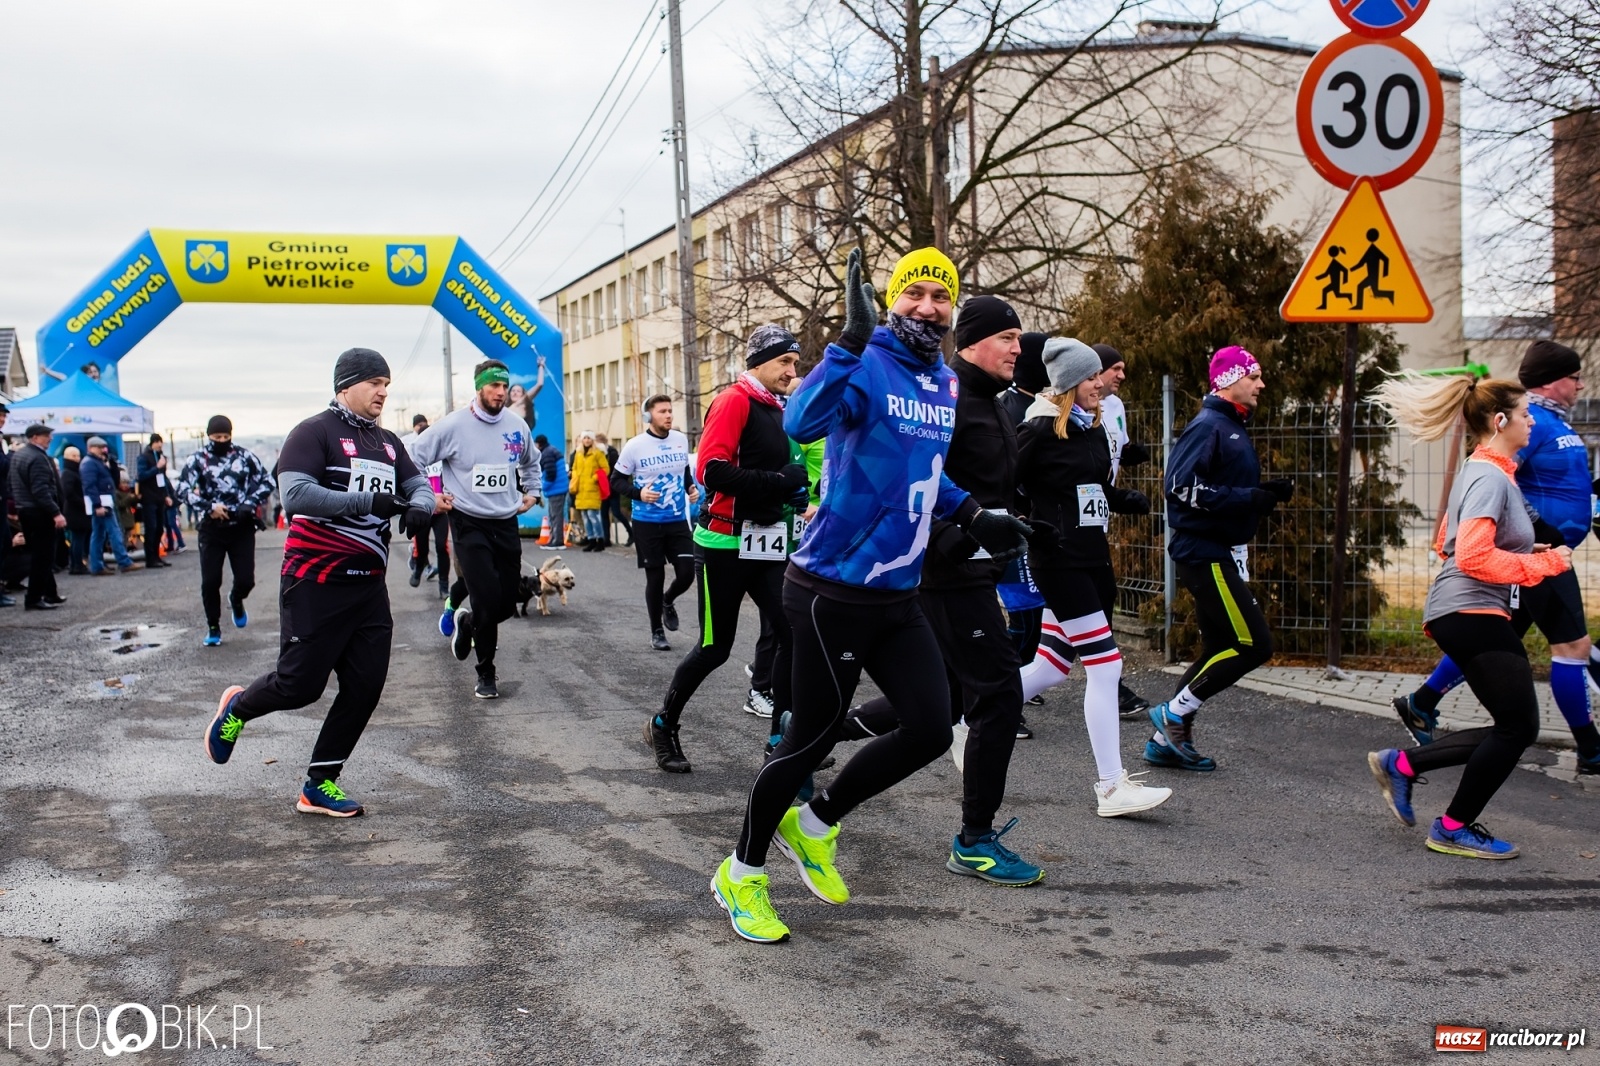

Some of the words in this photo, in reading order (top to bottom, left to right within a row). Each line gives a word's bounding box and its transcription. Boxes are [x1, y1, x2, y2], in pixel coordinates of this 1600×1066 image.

[1322, 71, 1420, 150] 30
[268, 241, 349, 253] Gmina
[247, 256, 370, 272] Pietrowice
[264, 274, 355, 289] Wielkie
[66, 289, 116, 333] Gmina
[110, 253, 152, 292] ludzi
[458, 261, 501, 305] Gmina
[500, 300, 537, 336] ludzi
[87, 273, 167, 347] aktywnych
[446, 279, 520, 349] aktywnych
[898, 422, 940, 441] EKO-OKNA
[354, 474, 393, 494] 185
[475, 474, 507, 487] 260
[1082, 499, 1109, 518] 466
[744, 534, 784, 553] 114
